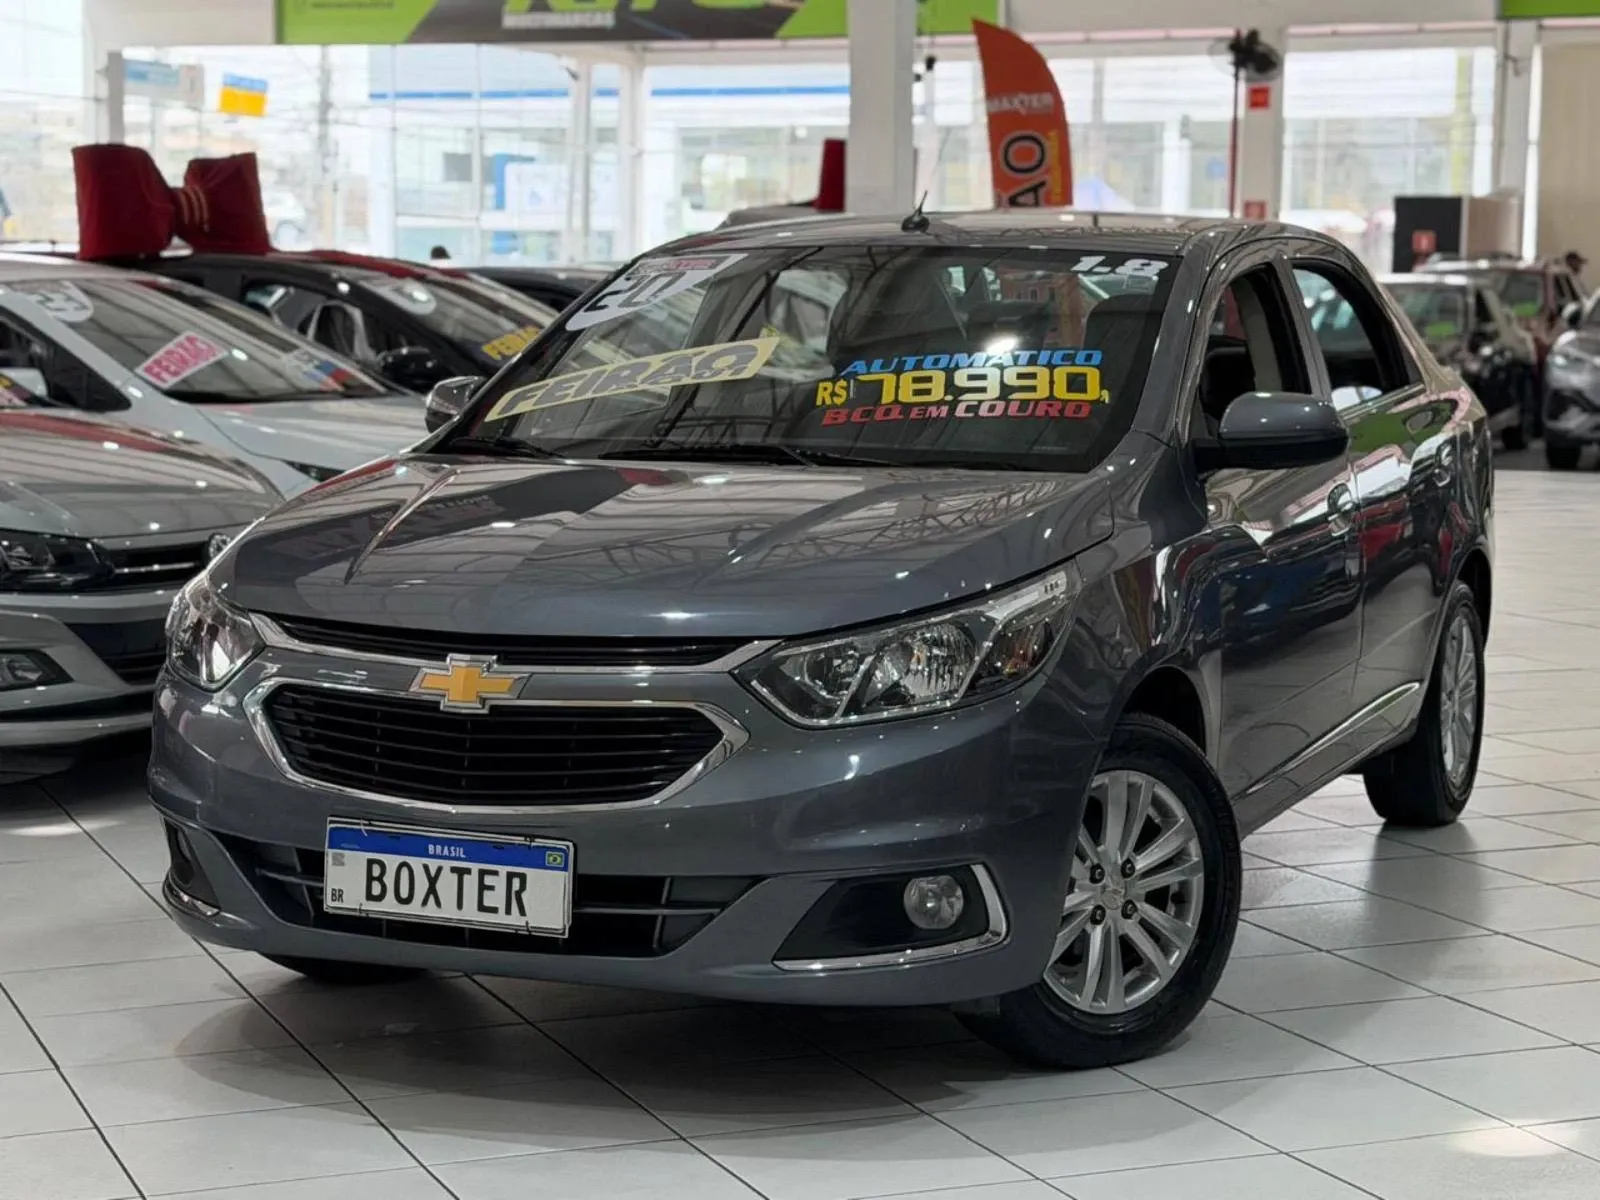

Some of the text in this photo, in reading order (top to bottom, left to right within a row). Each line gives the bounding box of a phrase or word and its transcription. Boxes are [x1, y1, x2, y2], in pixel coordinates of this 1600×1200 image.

[1069, 255, 1169, 278] 1.8
[910, 404, 949, 421] EM
[953, 399, 1092, 419] COURO
[427, 843, 467, 859] BRASIL
[330, 887, 345, 904] BR
[364, 857, 528, 918] BOXTER
